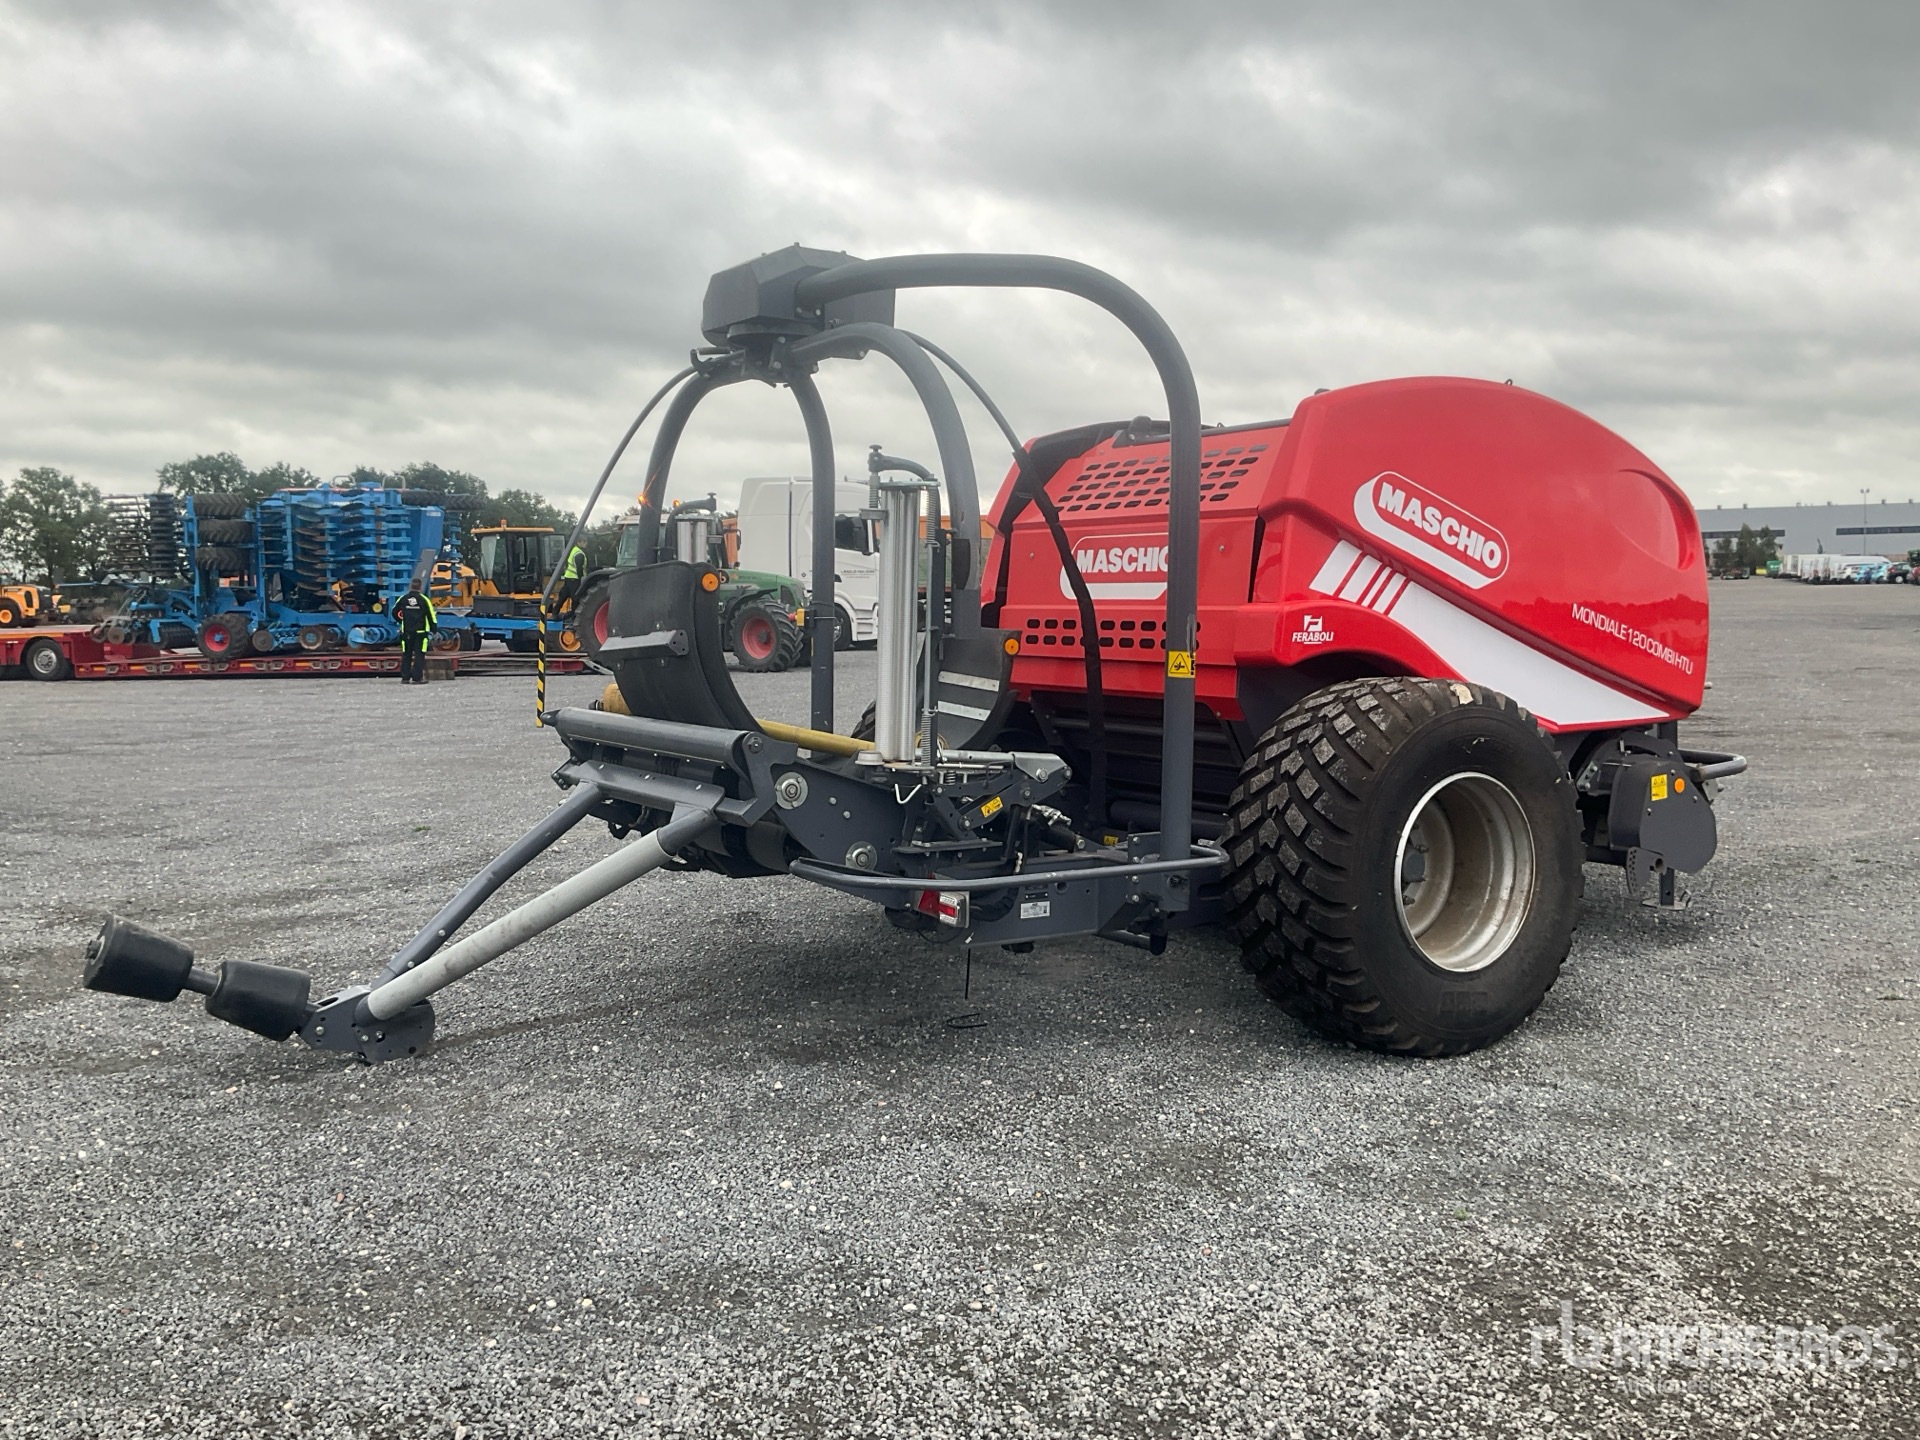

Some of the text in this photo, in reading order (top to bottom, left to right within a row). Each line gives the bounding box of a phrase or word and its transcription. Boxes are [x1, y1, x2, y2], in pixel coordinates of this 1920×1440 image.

[1378, 482, 1502, 569] MASCHIO
[1292, 631, 1335, 643] FERABOLI
[1571, 603, 1627, 640] MONDIALE
